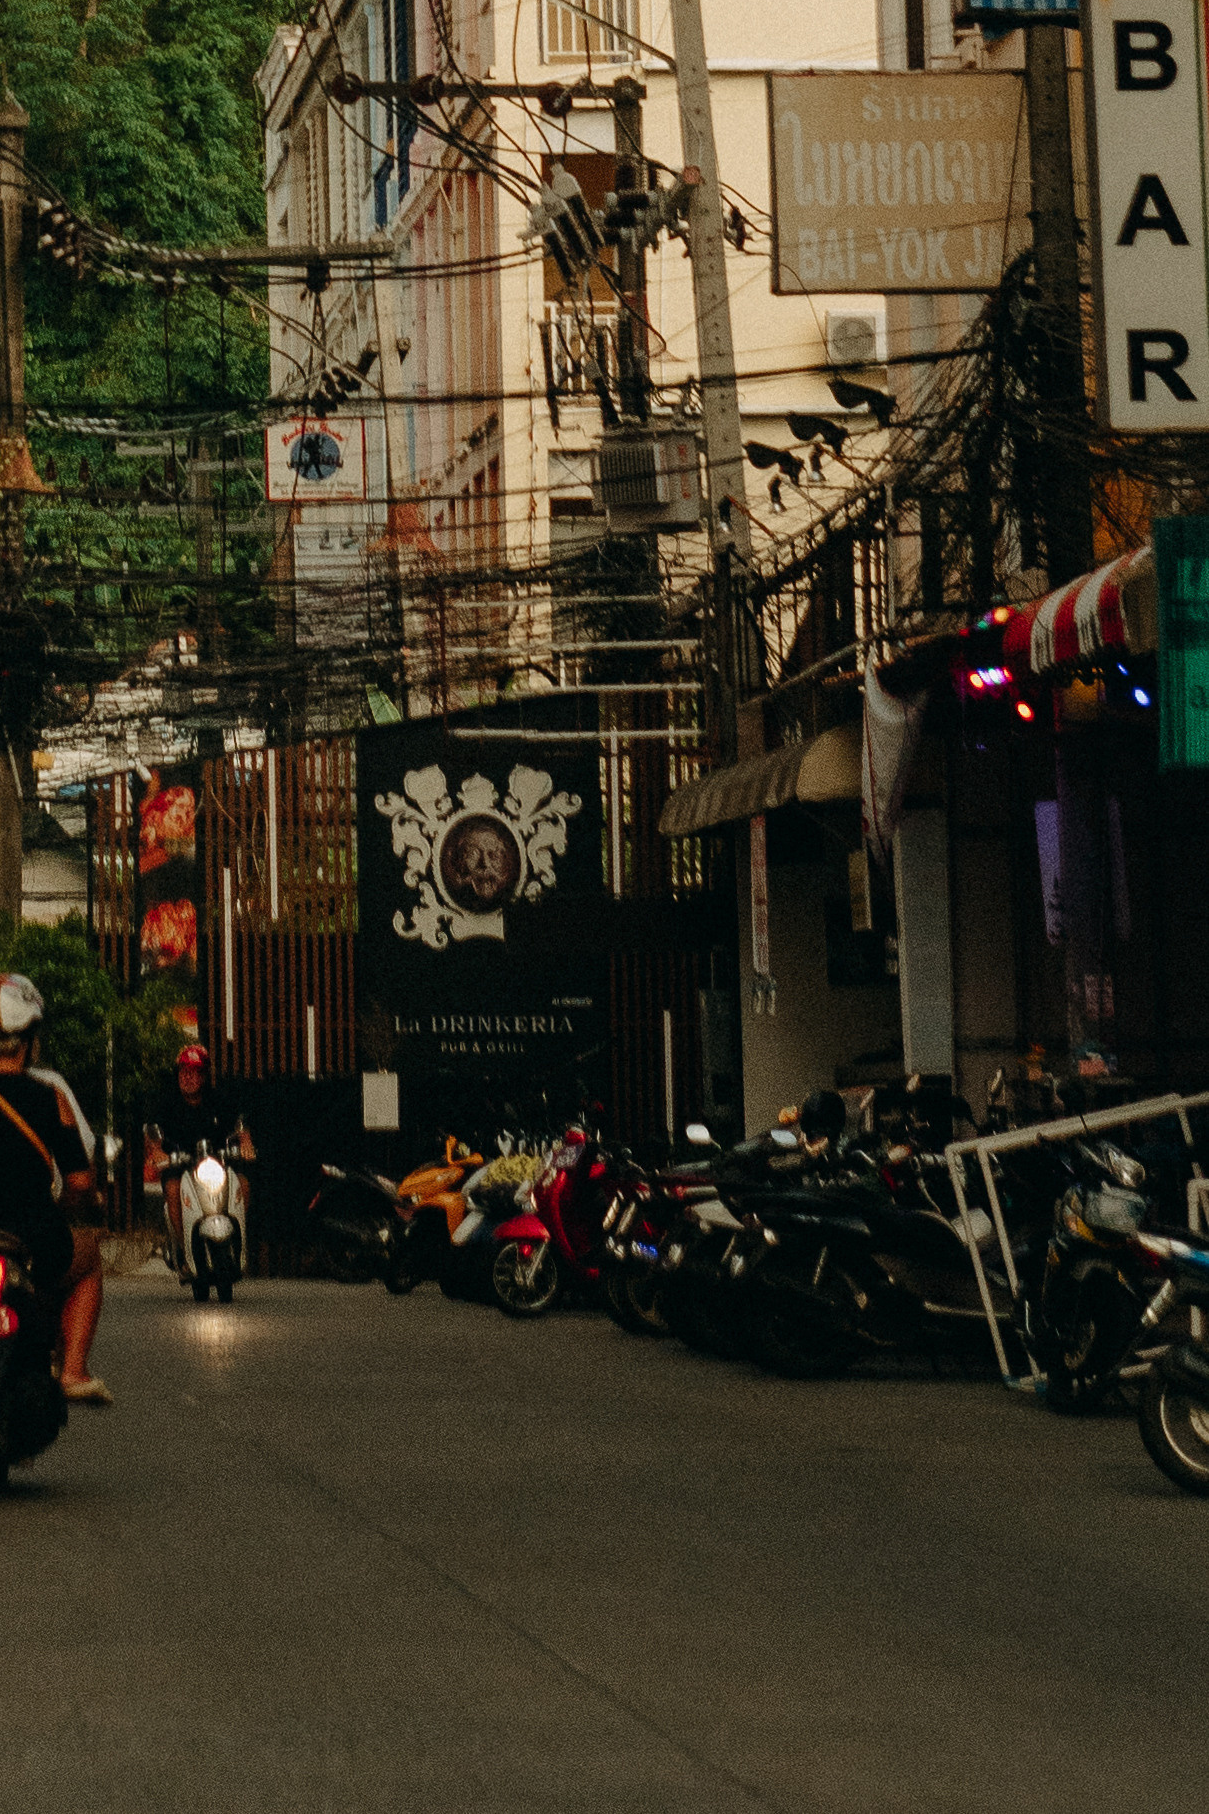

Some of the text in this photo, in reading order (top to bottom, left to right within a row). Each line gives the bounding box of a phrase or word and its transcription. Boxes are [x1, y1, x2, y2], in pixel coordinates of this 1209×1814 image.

[1112, 19, 1199, 403] BAR
[798, 226, 952, 281] BAI-YOK
[431, 1014, 574, 1033] DRINKERIA
[441, 1041, 467, 1053] PUB
[472, 1040, 481, 1053] &
